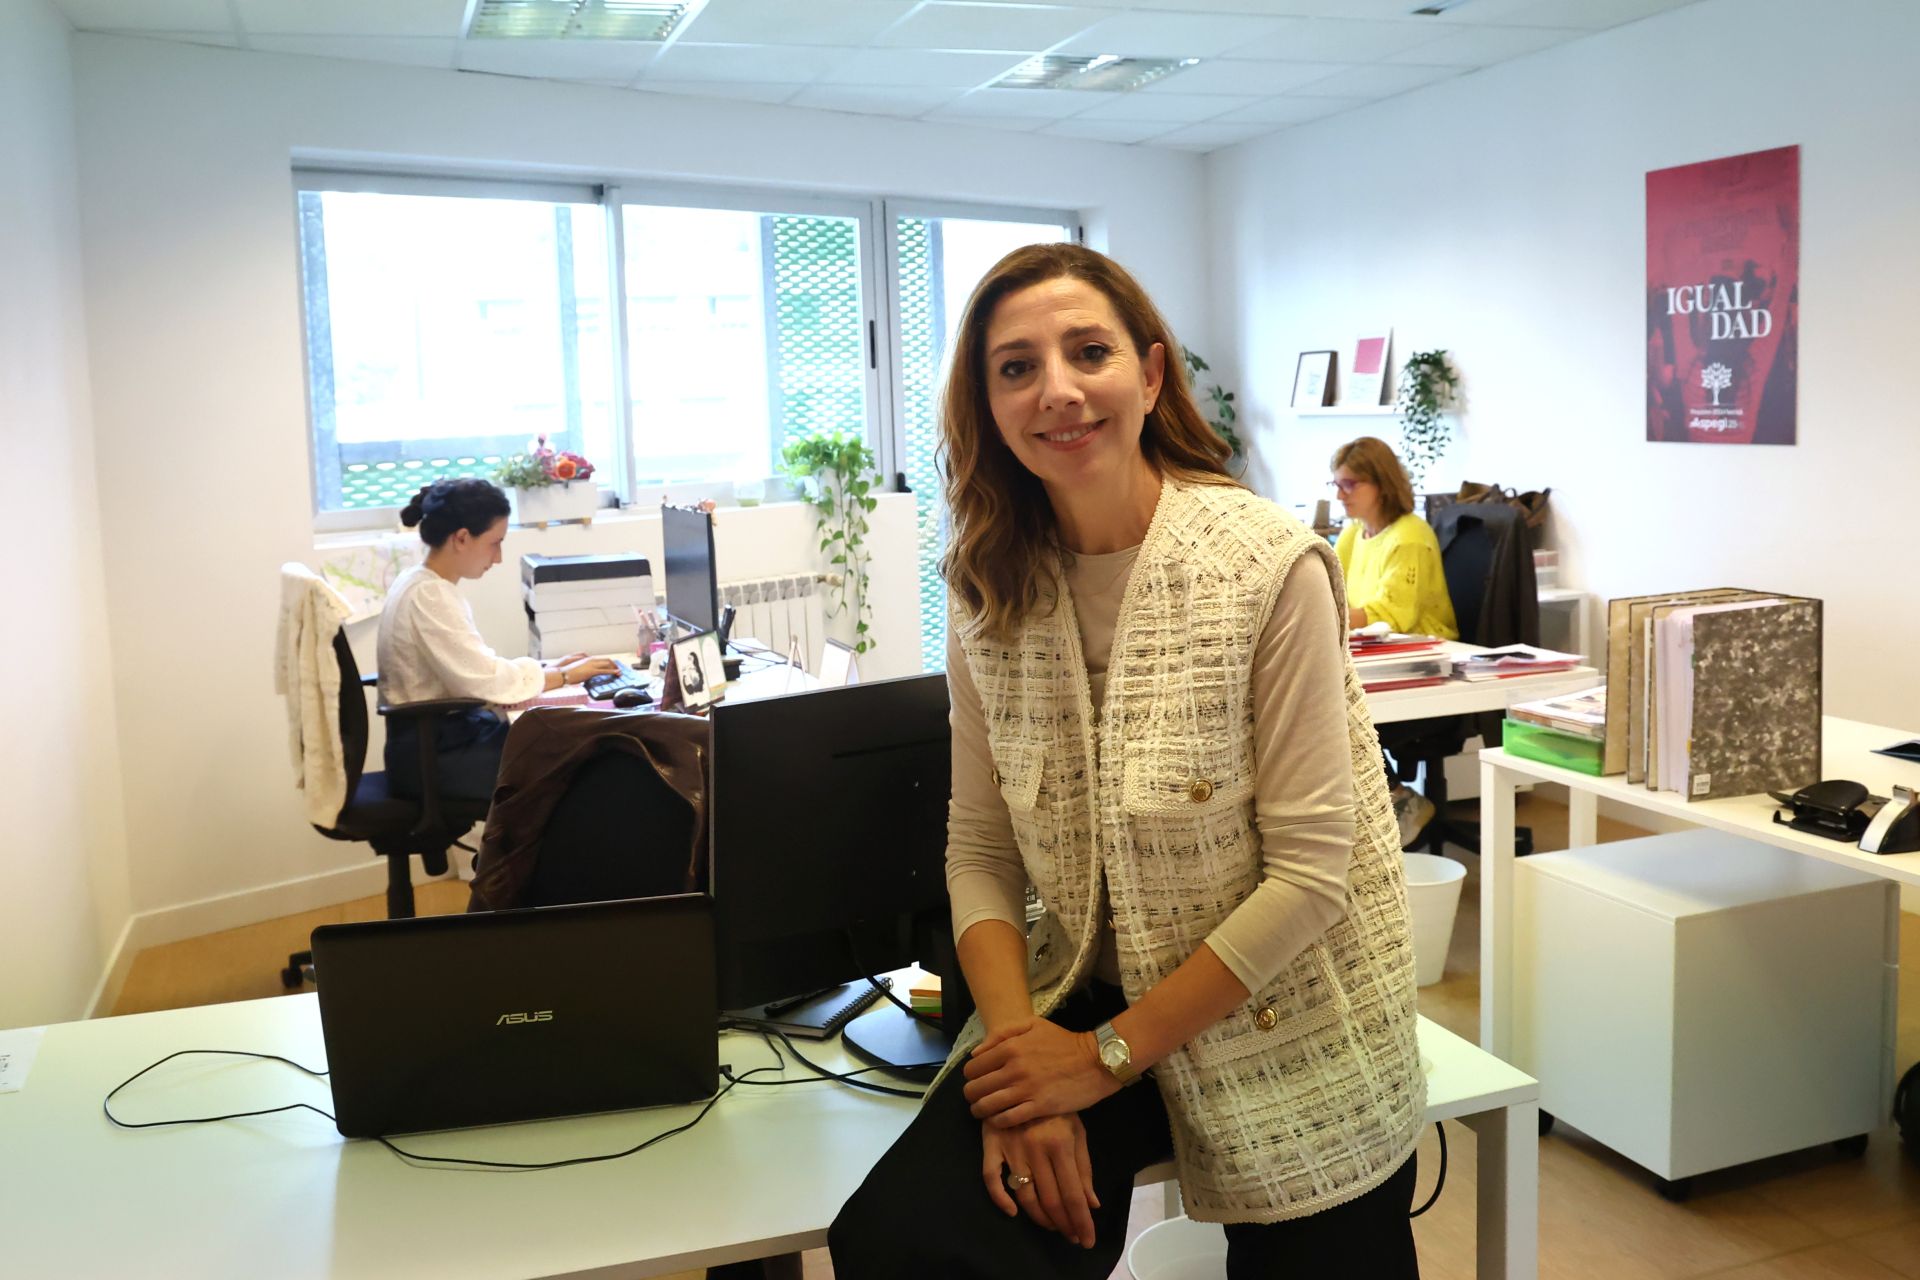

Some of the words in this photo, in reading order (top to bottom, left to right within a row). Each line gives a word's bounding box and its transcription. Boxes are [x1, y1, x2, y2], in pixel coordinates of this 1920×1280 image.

[1666, 281, 1752, 315] IGUAL
[1711, 308, 1772, 340] DAD
[496, 1010, 553, 1026] ASUS
